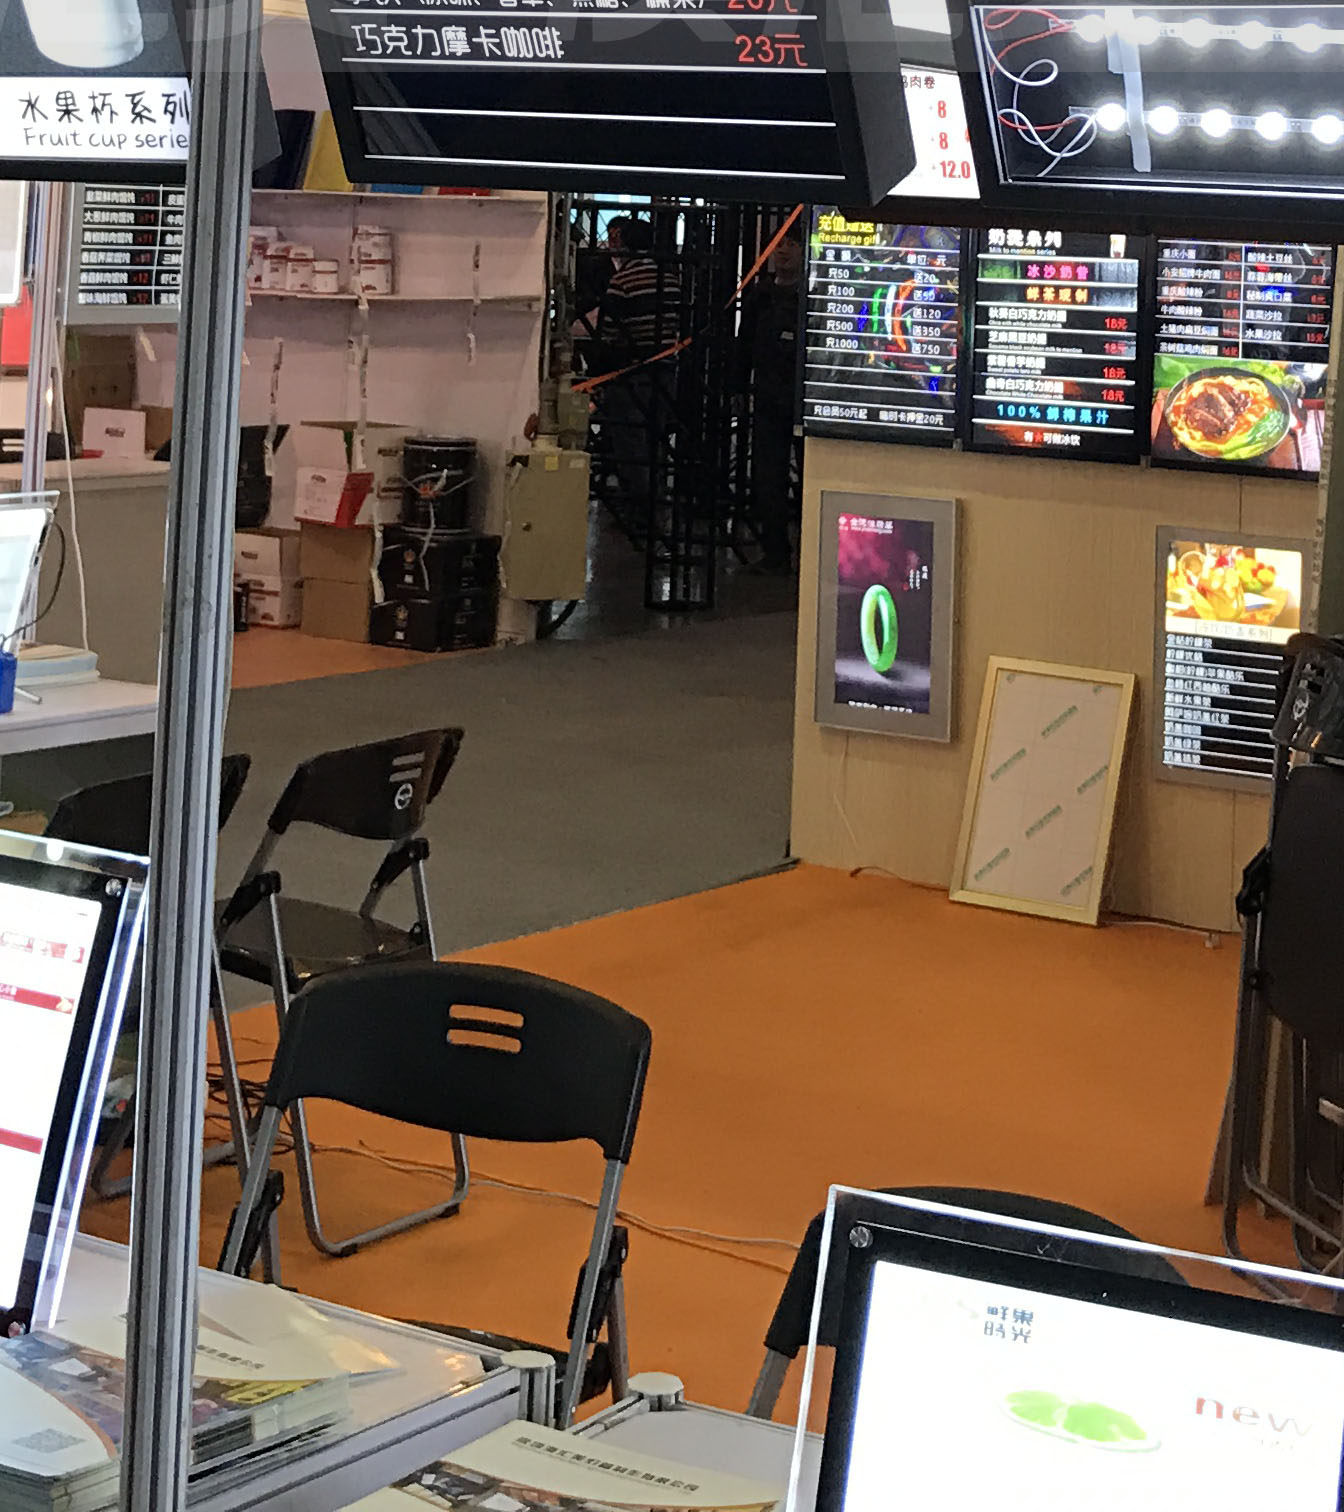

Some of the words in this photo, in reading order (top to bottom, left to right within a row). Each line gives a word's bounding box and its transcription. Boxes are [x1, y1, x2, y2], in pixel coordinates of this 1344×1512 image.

[352, 24, 565, 60] 巧克力摩卡咖啡
[734, 33, 808, 68] 23元
[17, 90, 191, 126] 水果杯系列
[24, 127, 82, 148] Fruit
[88, 131, 129, 153] cup
[133, 129, 189, 148] serie
